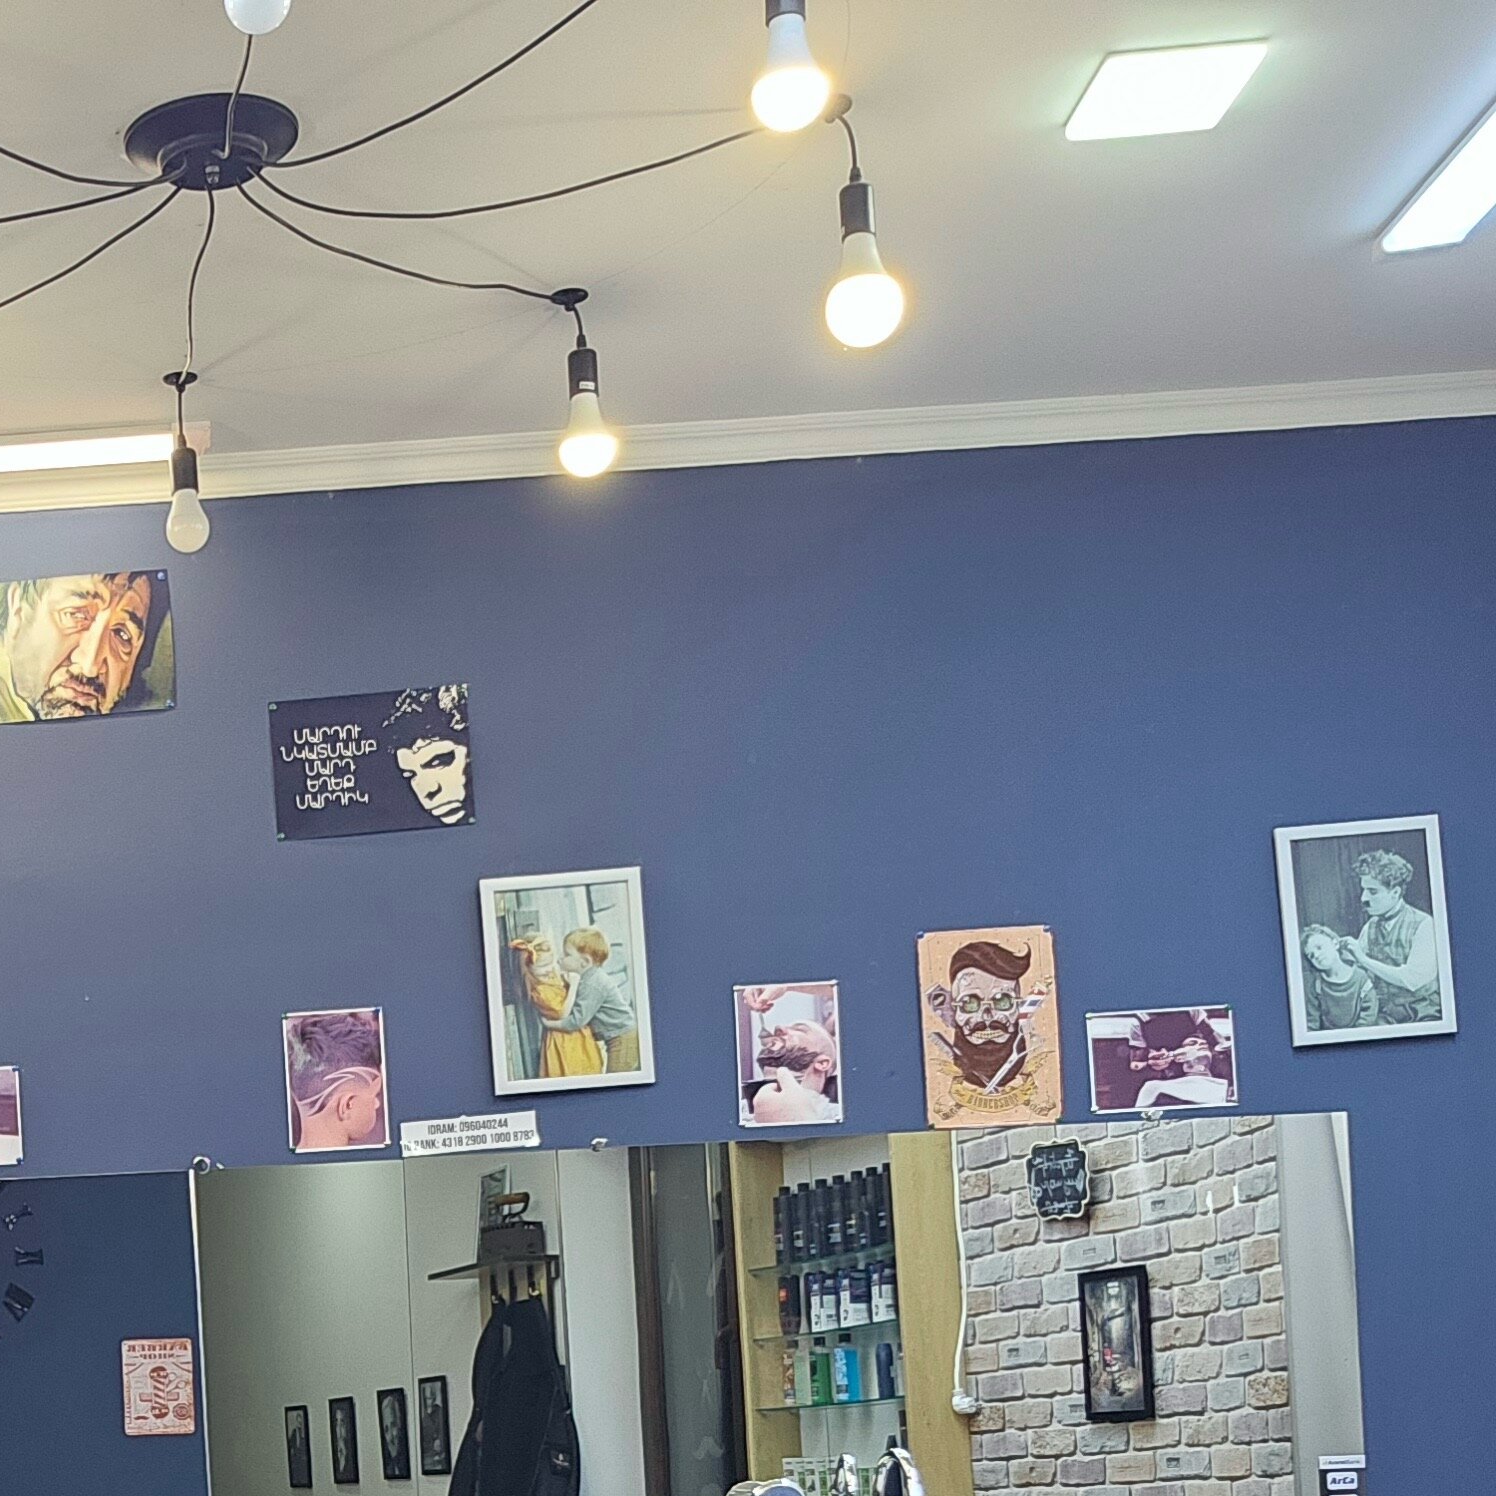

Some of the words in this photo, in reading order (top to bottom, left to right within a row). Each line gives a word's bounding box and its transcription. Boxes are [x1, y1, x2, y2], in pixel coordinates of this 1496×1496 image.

[293, 724, 362, 744] ՄԱՐԴՈՒ
[280, 739, 377, 762] ՆԿԱՏՄԱՄԲ
[305, 759, 356, 776] ՄԱՐԴ
[306, 775, 355, 792] ԵՂԵՔ
[296, 790, 369, 810] ՄԱՐԴԻԿ
[1330, 1476, 1355, 1485] ArCa
